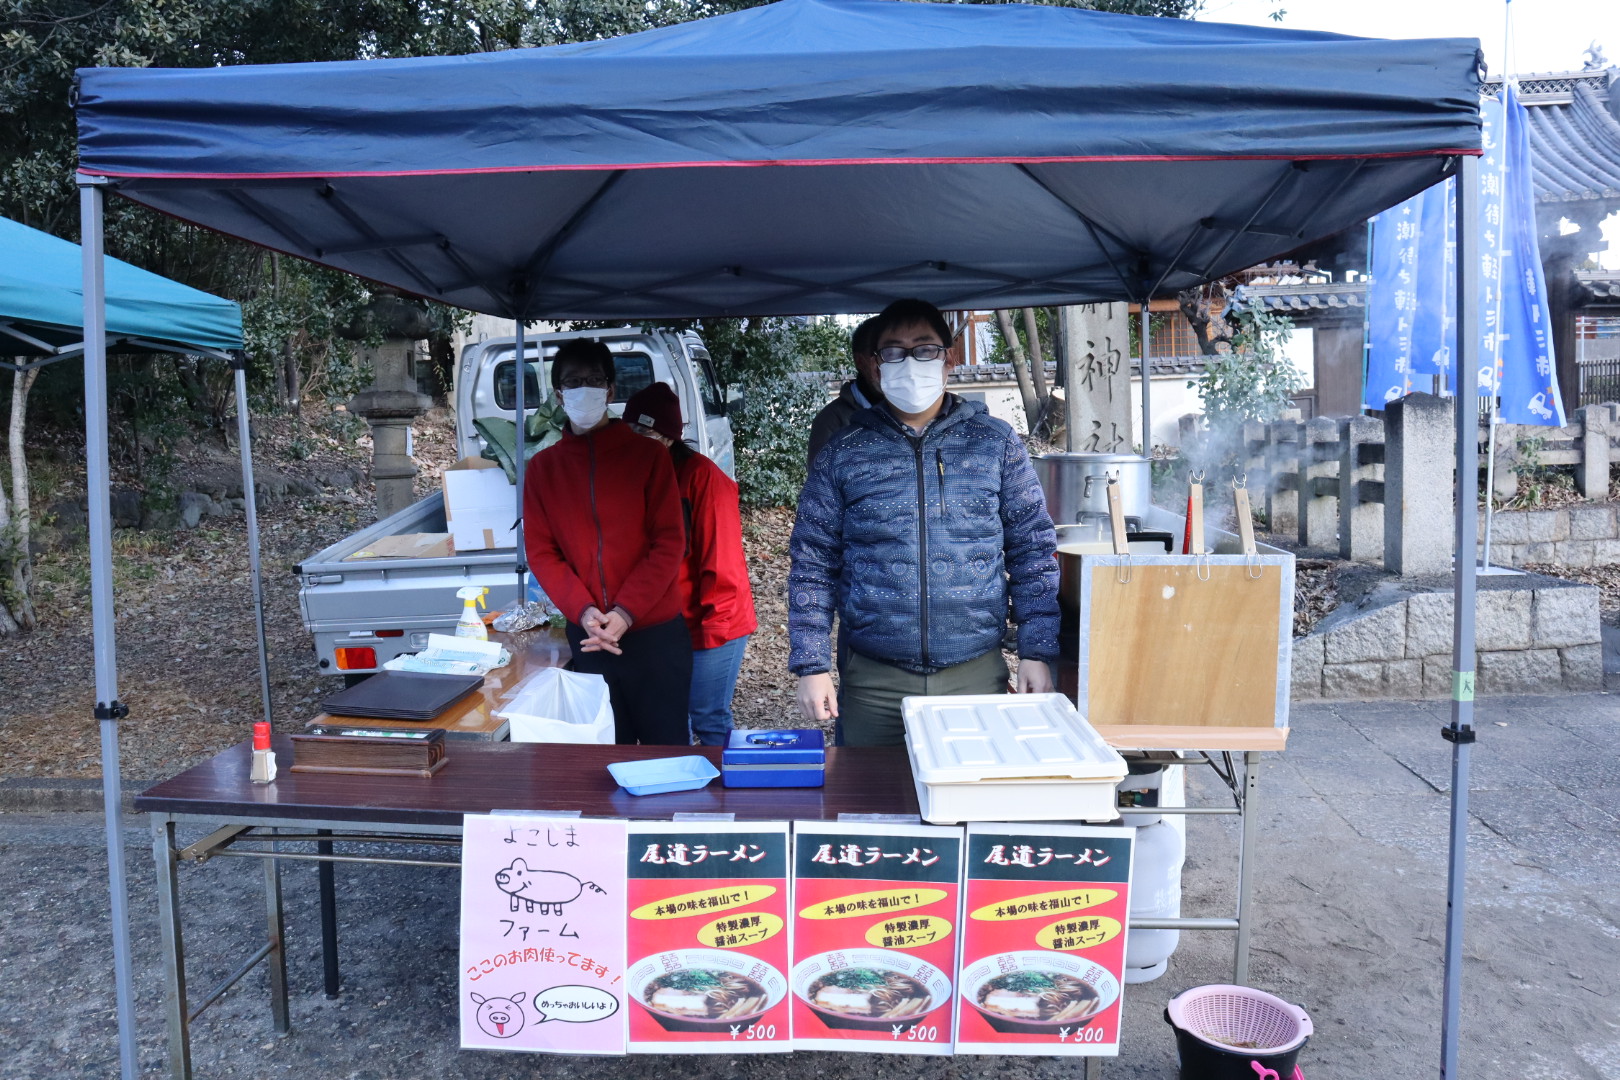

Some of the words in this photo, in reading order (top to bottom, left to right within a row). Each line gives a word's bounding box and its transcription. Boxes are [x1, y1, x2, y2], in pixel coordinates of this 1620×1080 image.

[1074, 302, 1125, 453] 神社
[503, 825, 580, 847] よこしま
[640, 843, 767, 866] 尾道ラーメン
[811, 844, 940, 867] 尾道ラーメン
[983, 844, 1113, 867] 尾道ラーメン
[655, 891, 749, 916] 本場の味を福山で！
[823, 893, 920, 916] 本場の味を福山で！
[994, 894, 1091, 918] 本場の味を福山で！
[499, 919, 580, 941] ファーム
[715, 916, 762, 933] 特製濃厚
[884, 919, 930, 934] 特製濃厚
[1055, 919, 1101, 936] 特製濃厚
[714, 928, 769, 947] 醤油スープ
[882, 931, 937, 948] 醤油スープ
[1052, 931, 1106, 950] 醤油スープ
[466, 947, 622, 985] ここのお肉使ってます！
[540, 999, 614, 1011] めっちゃおいしいよ！
